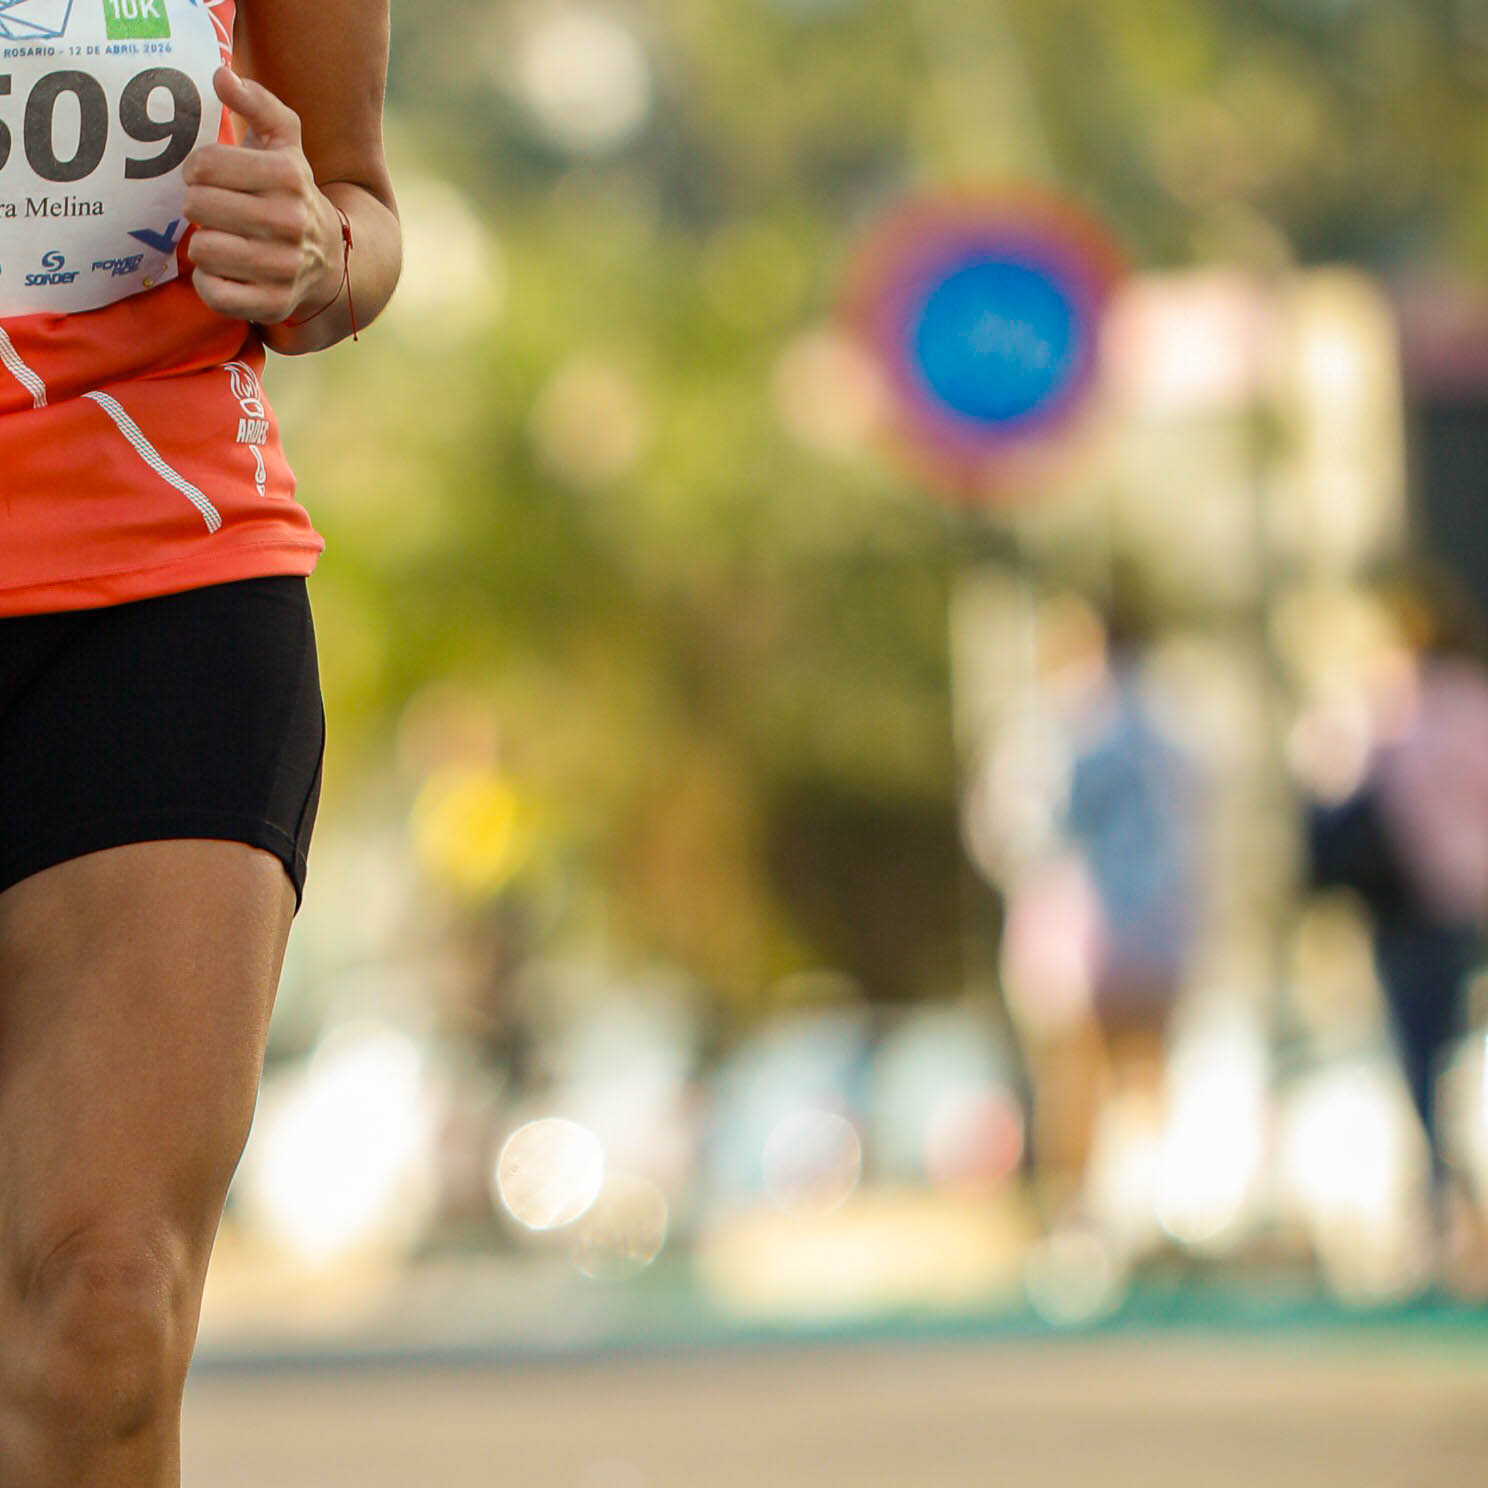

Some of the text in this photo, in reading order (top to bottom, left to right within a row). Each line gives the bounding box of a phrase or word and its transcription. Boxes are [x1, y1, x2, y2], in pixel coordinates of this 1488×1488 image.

[3, 47, 55, 58] ROSARIO
[68, 46, 83, 56] 12
[86, 45, 101, 55] DE
[105, 44, 139, 55] ABRIL
[143, 43, 173, 53] 2026
[25, 196, 104, 218] Melina
